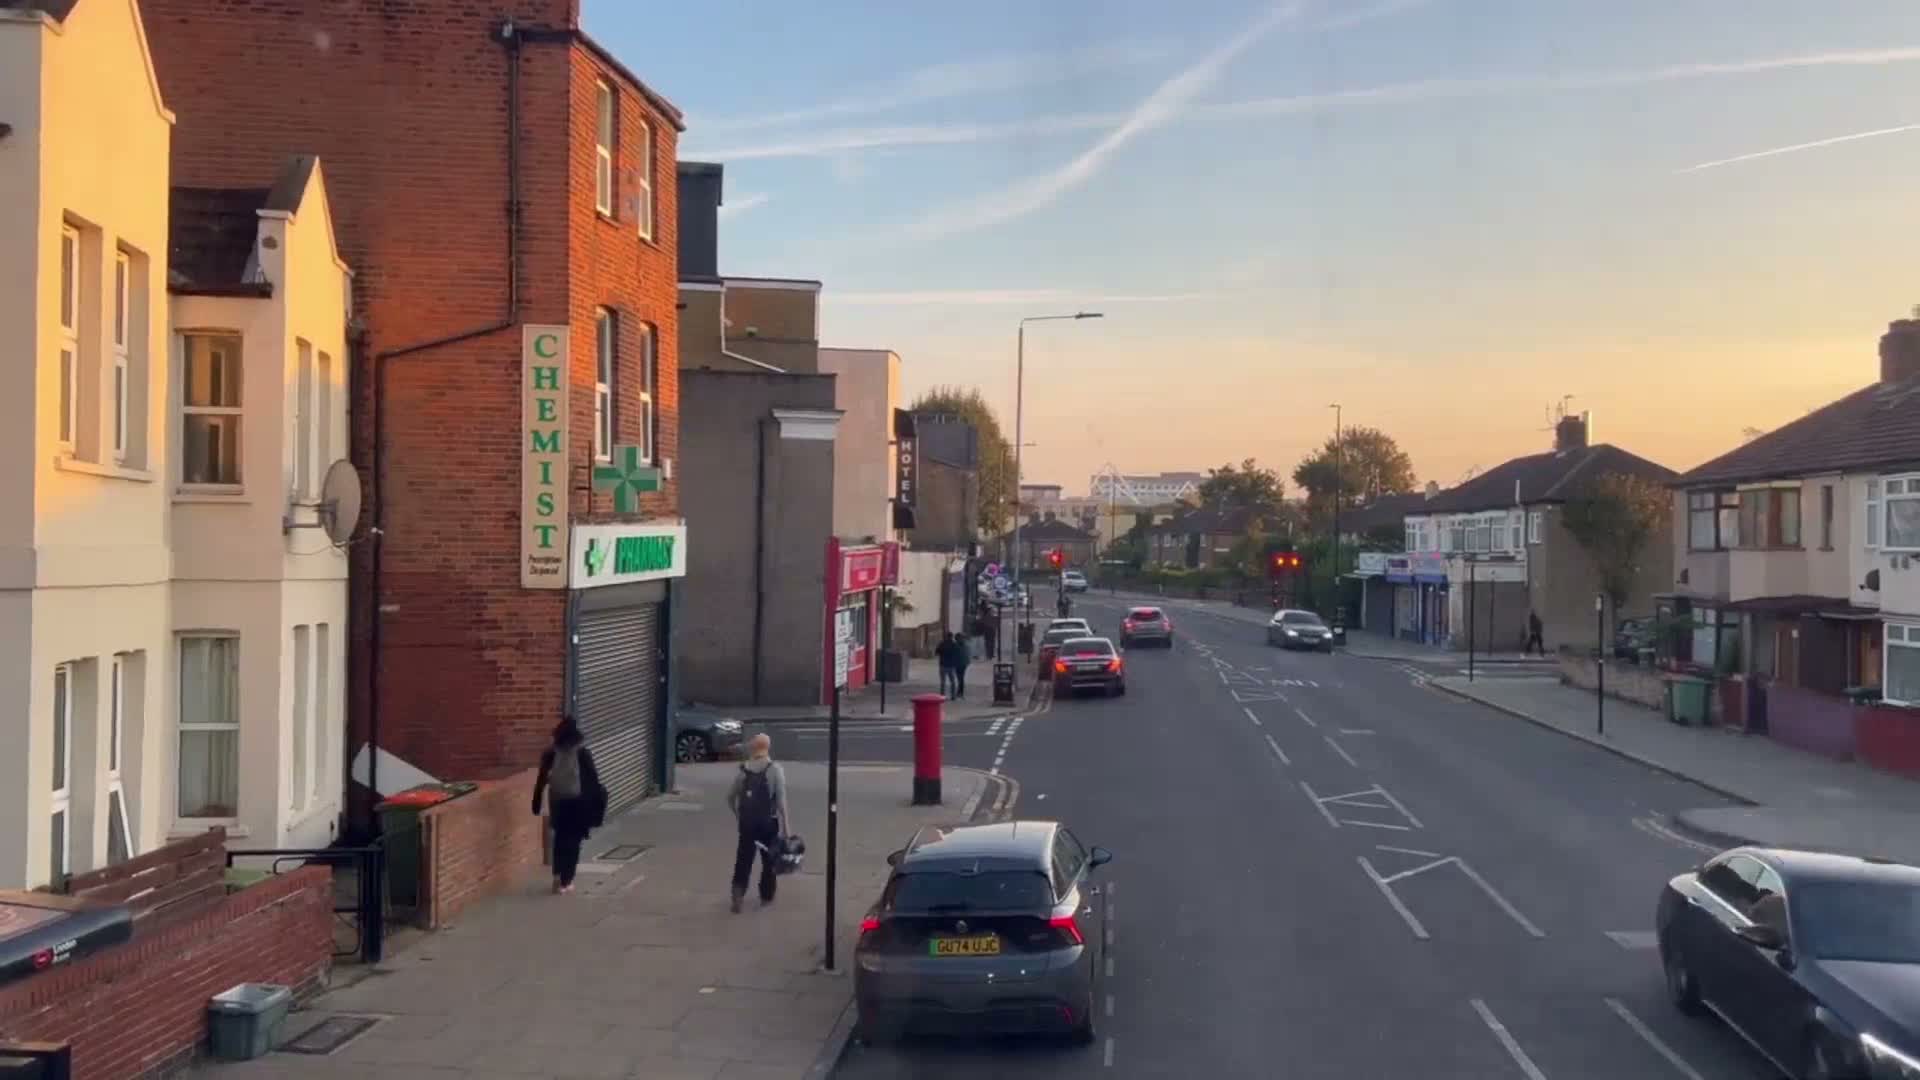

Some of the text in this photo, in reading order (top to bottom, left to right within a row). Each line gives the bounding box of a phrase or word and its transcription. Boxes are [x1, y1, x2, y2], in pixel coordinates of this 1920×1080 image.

[531, 334, 561, 548] CHEMIST
[901, 441, 911, 503] HOTEL
[938, 939, 998, 953] GU74 UJC
